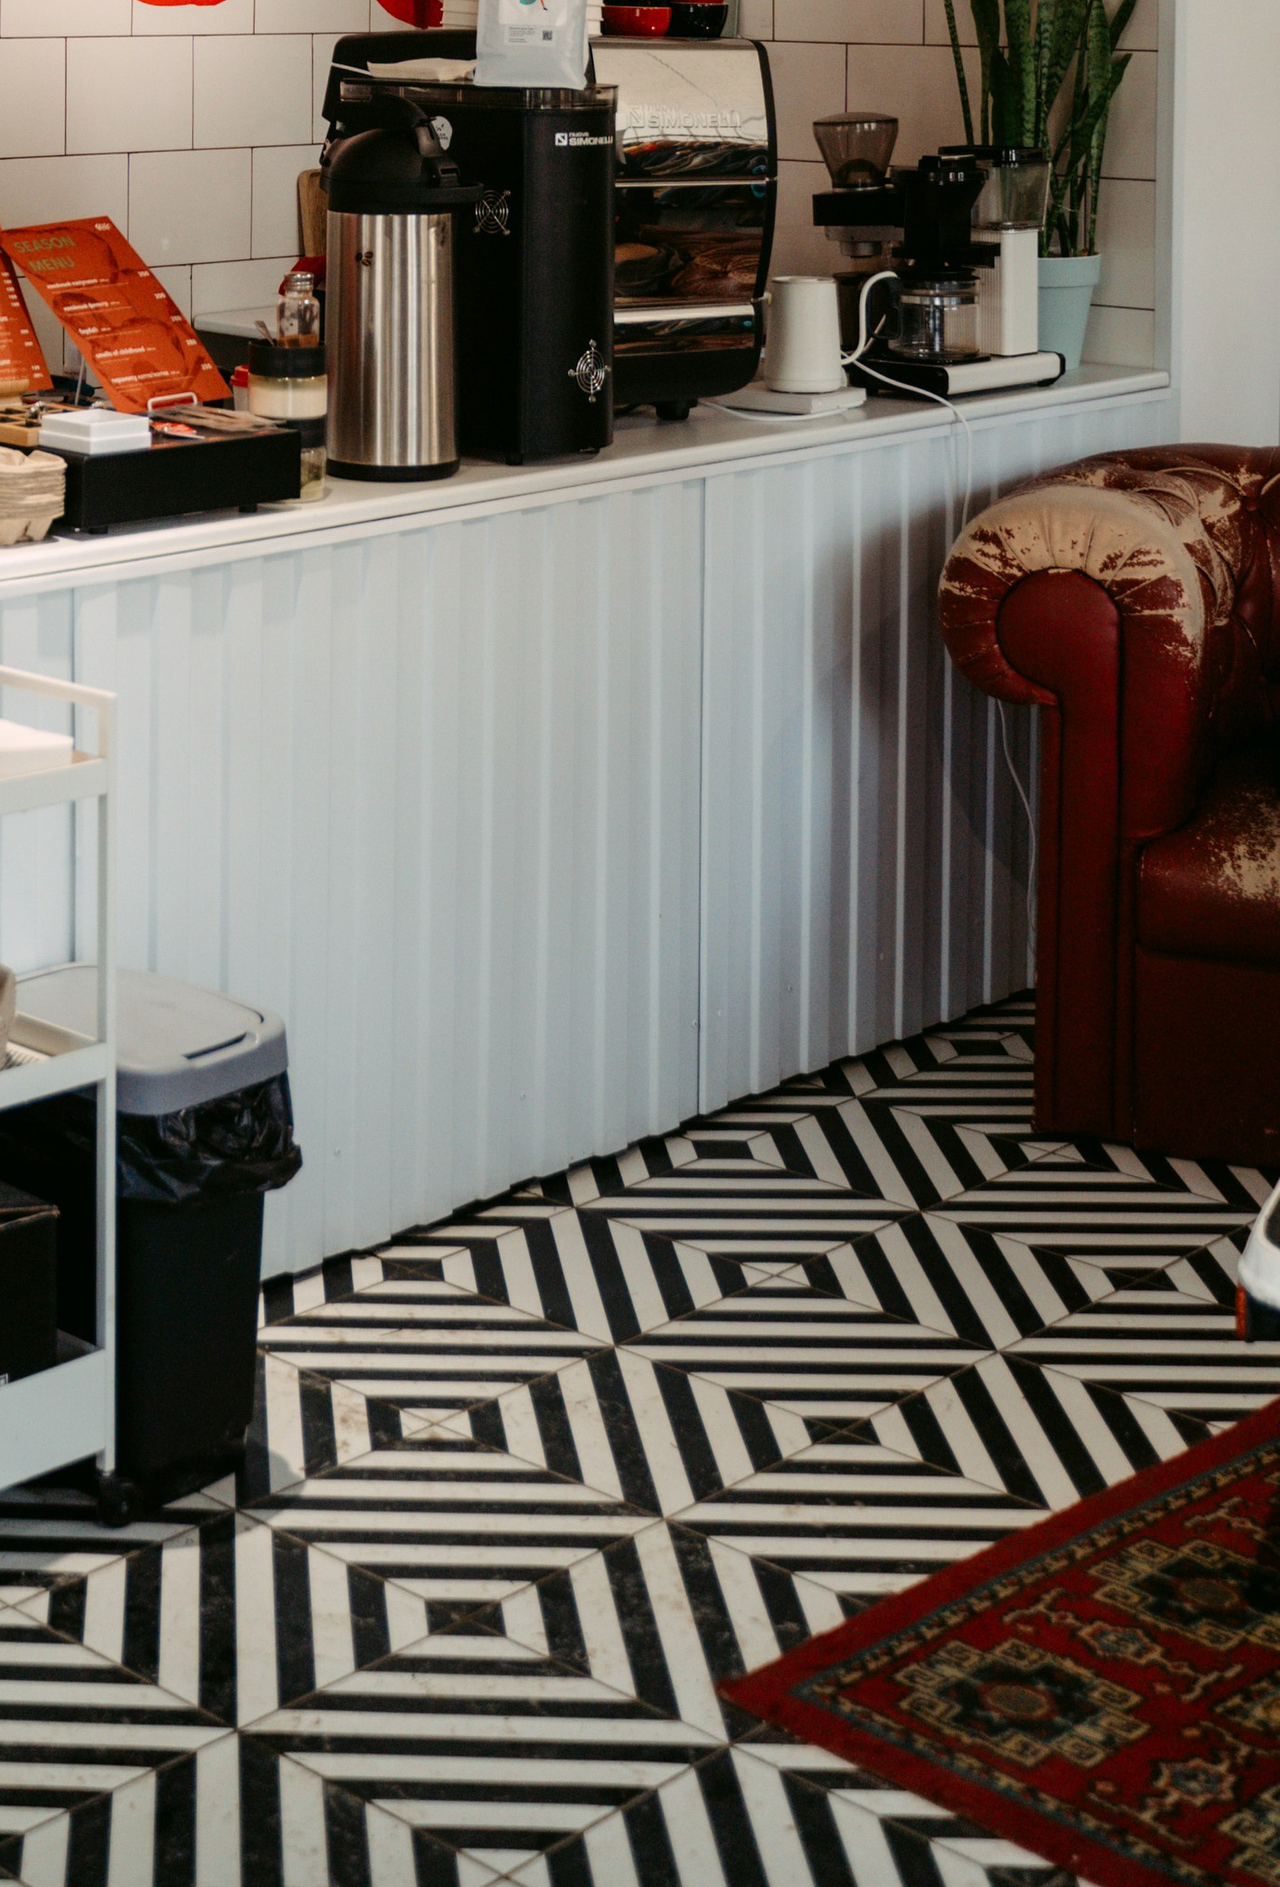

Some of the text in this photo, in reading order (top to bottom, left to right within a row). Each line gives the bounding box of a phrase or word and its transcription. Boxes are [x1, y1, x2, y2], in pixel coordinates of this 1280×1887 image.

[648, 112, 742, 129] SIMONELLI
[569, 136, 613, 146] SIMONELLI
[13, 236, 76, 254] SEASON
[28, 256, 75, 272] MENU
